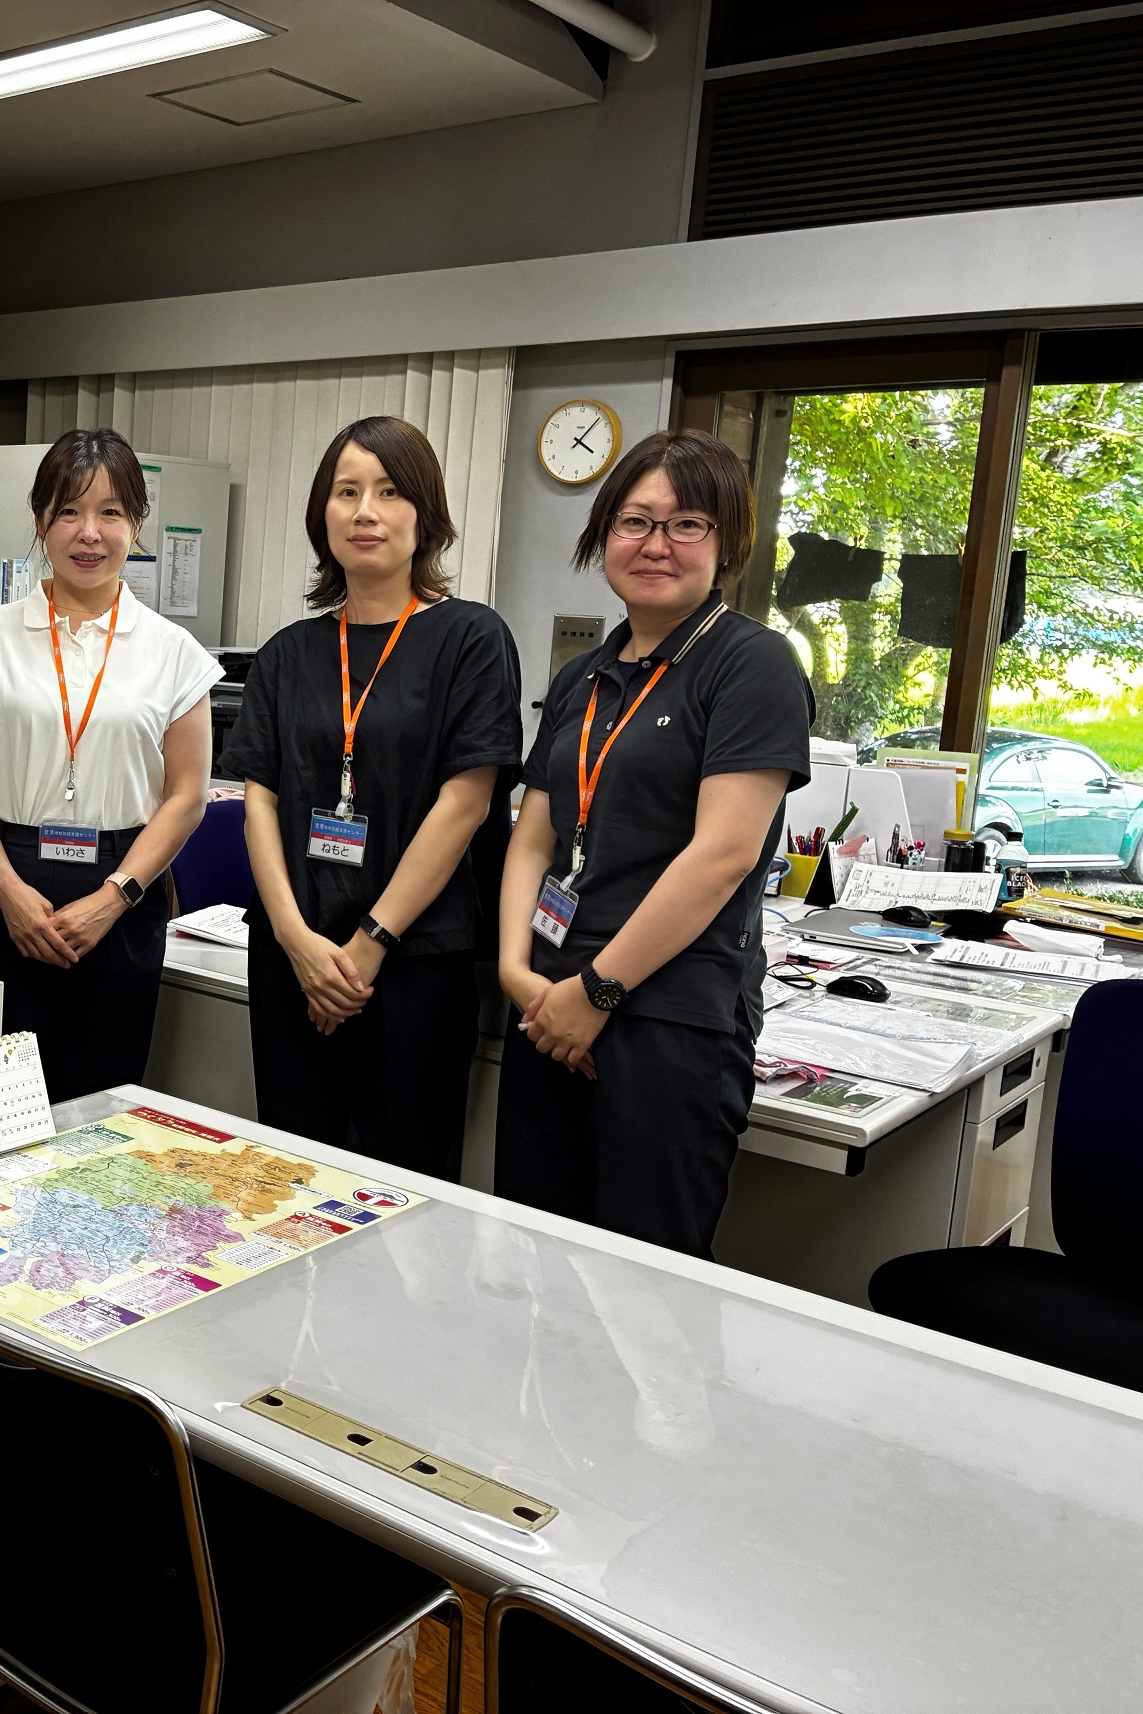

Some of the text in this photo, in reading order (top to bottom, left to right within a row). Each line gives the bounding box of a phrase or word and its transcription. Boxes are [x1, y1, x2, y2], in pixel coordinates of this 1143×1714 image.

[55, 846, 86, 858] いわさ
[321, 842, 350, 858] ねもと
